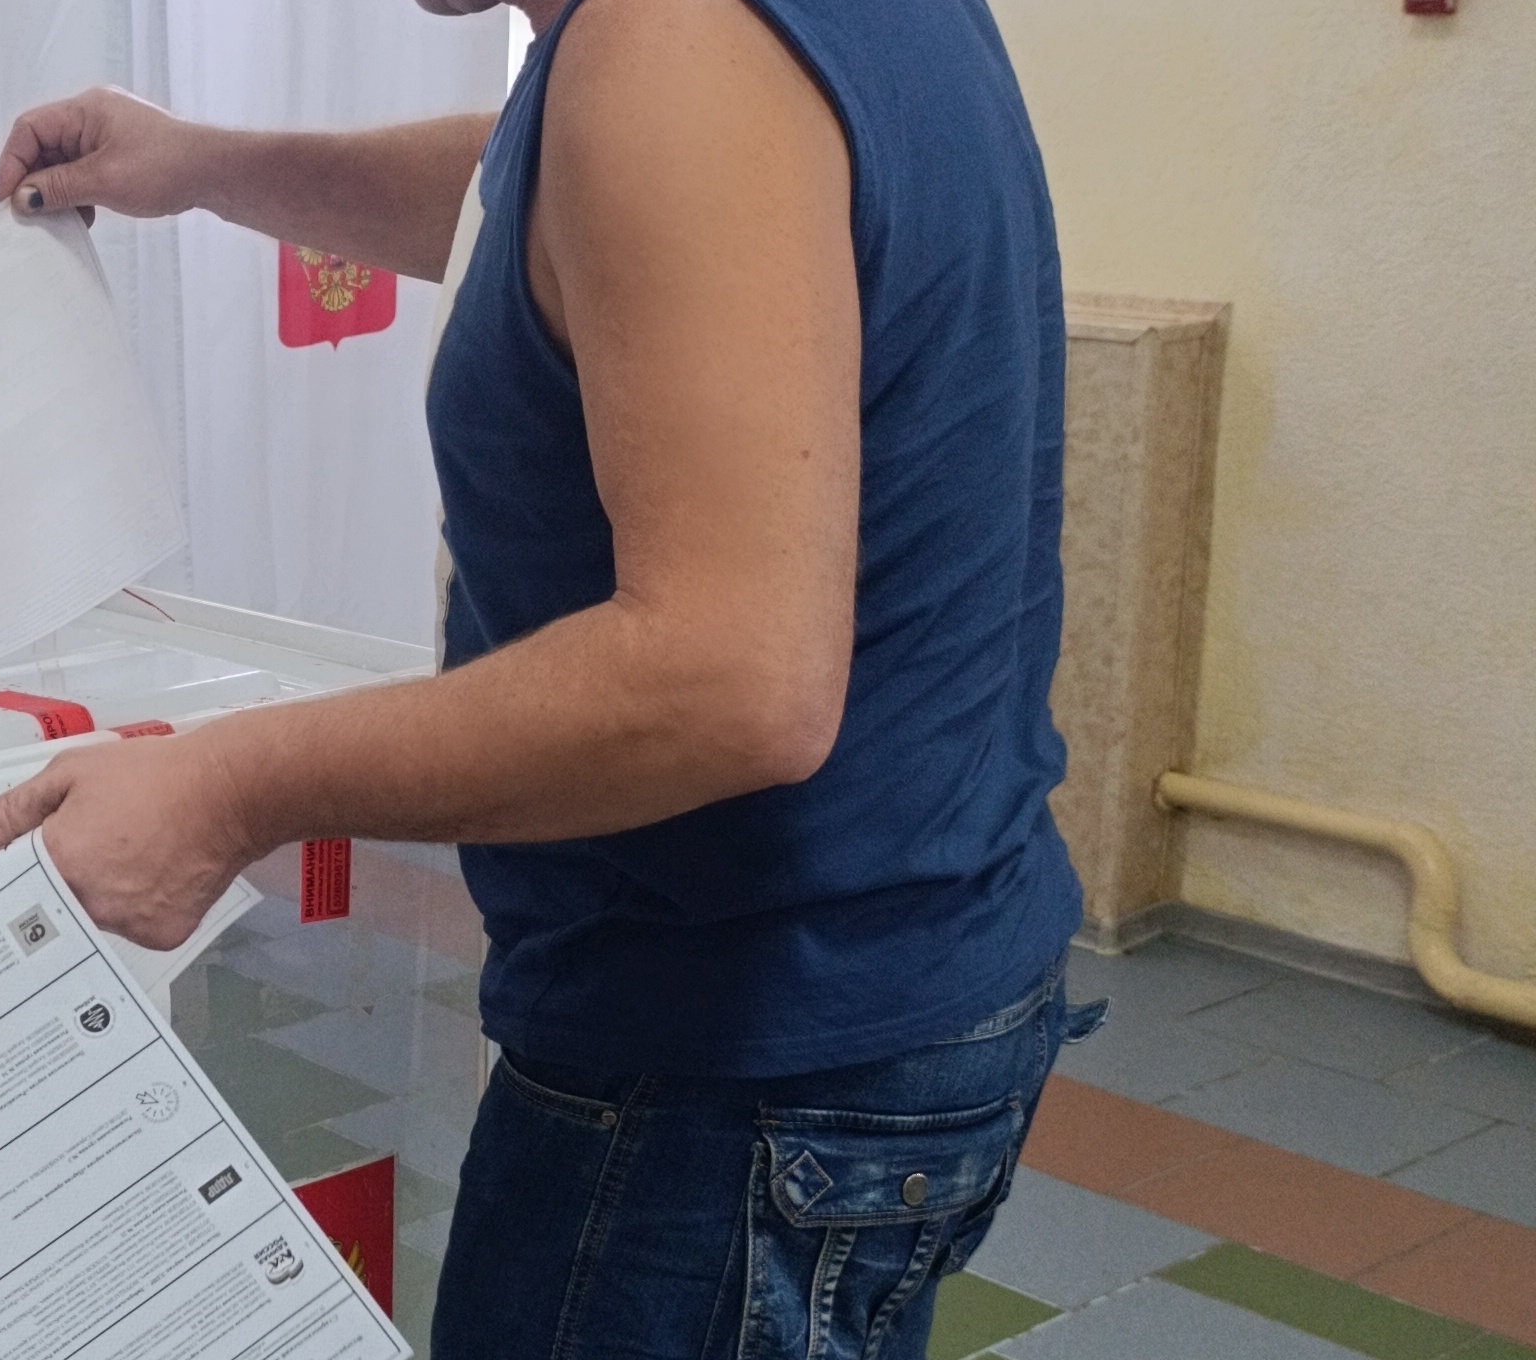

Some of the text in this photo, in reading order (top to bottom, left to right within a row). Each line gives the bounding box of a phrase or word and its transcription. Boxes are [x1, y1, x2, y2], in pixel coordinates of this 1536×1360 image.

[24, 920, 49, 944] СР
[202, 1169, 237, 1199] ЛДПР
[252, 1234, 285, 1261] РОССИЯ
[256, 1239, 289, 1266] ЕДИНАЯ
